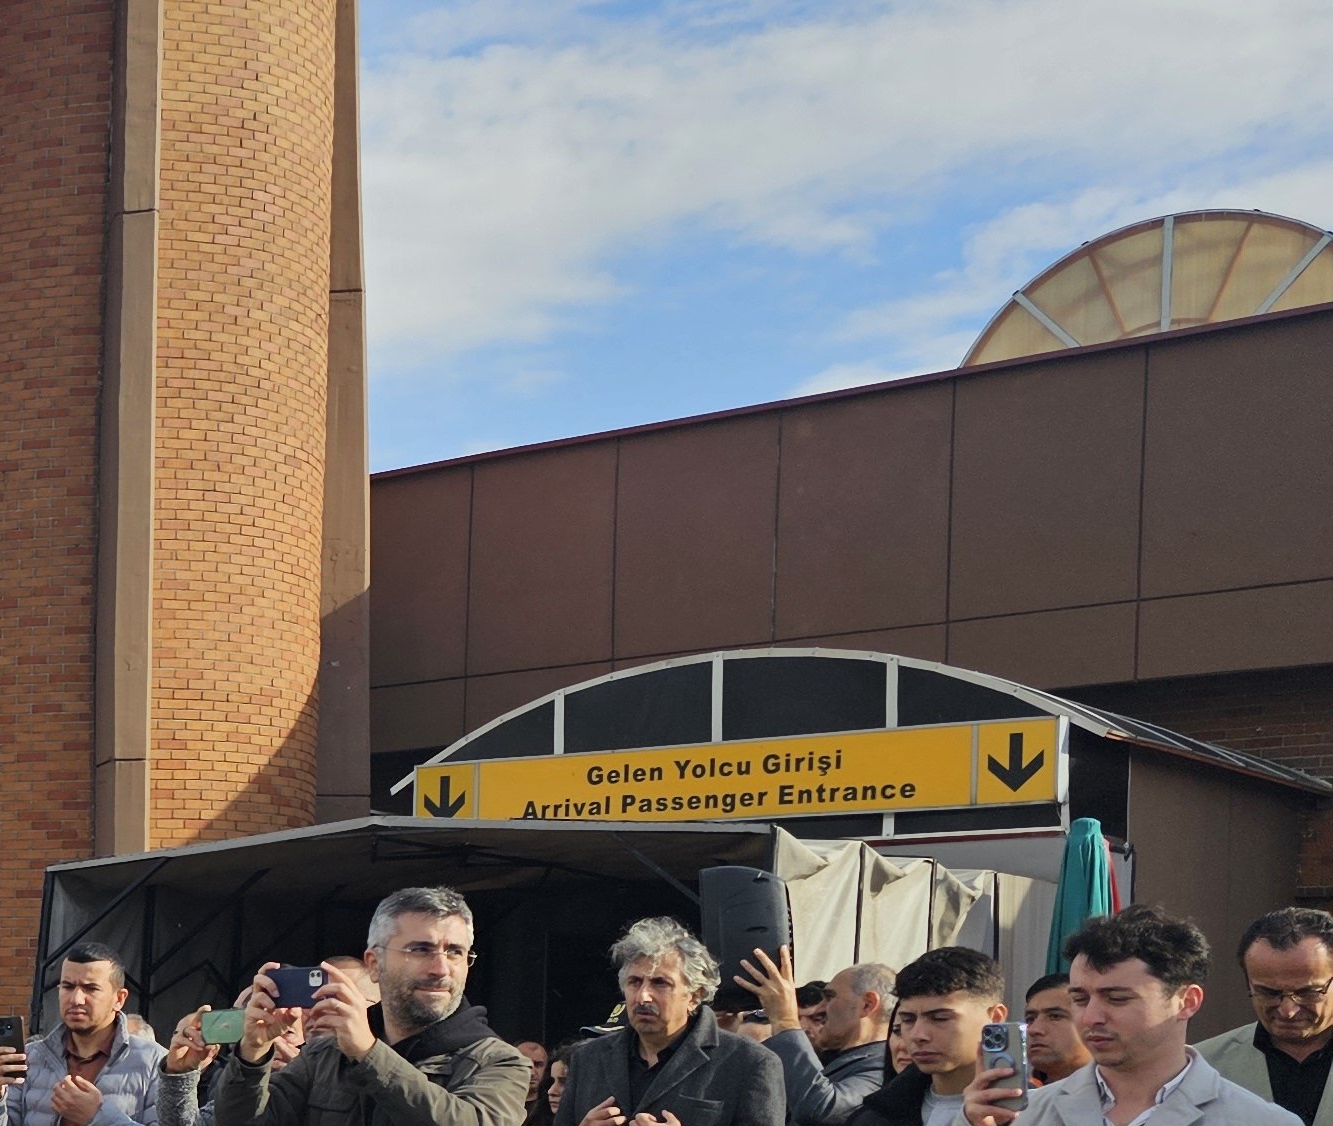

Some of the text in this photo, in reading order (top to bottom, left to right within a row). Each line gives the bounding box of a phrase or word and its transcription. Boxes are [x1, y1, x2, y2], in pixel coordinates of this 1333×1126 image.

[587, 750, 842, 786] Gelen Yolcu Girişi
[522, 783, 916, 820] Arrival Passenger Entrance
